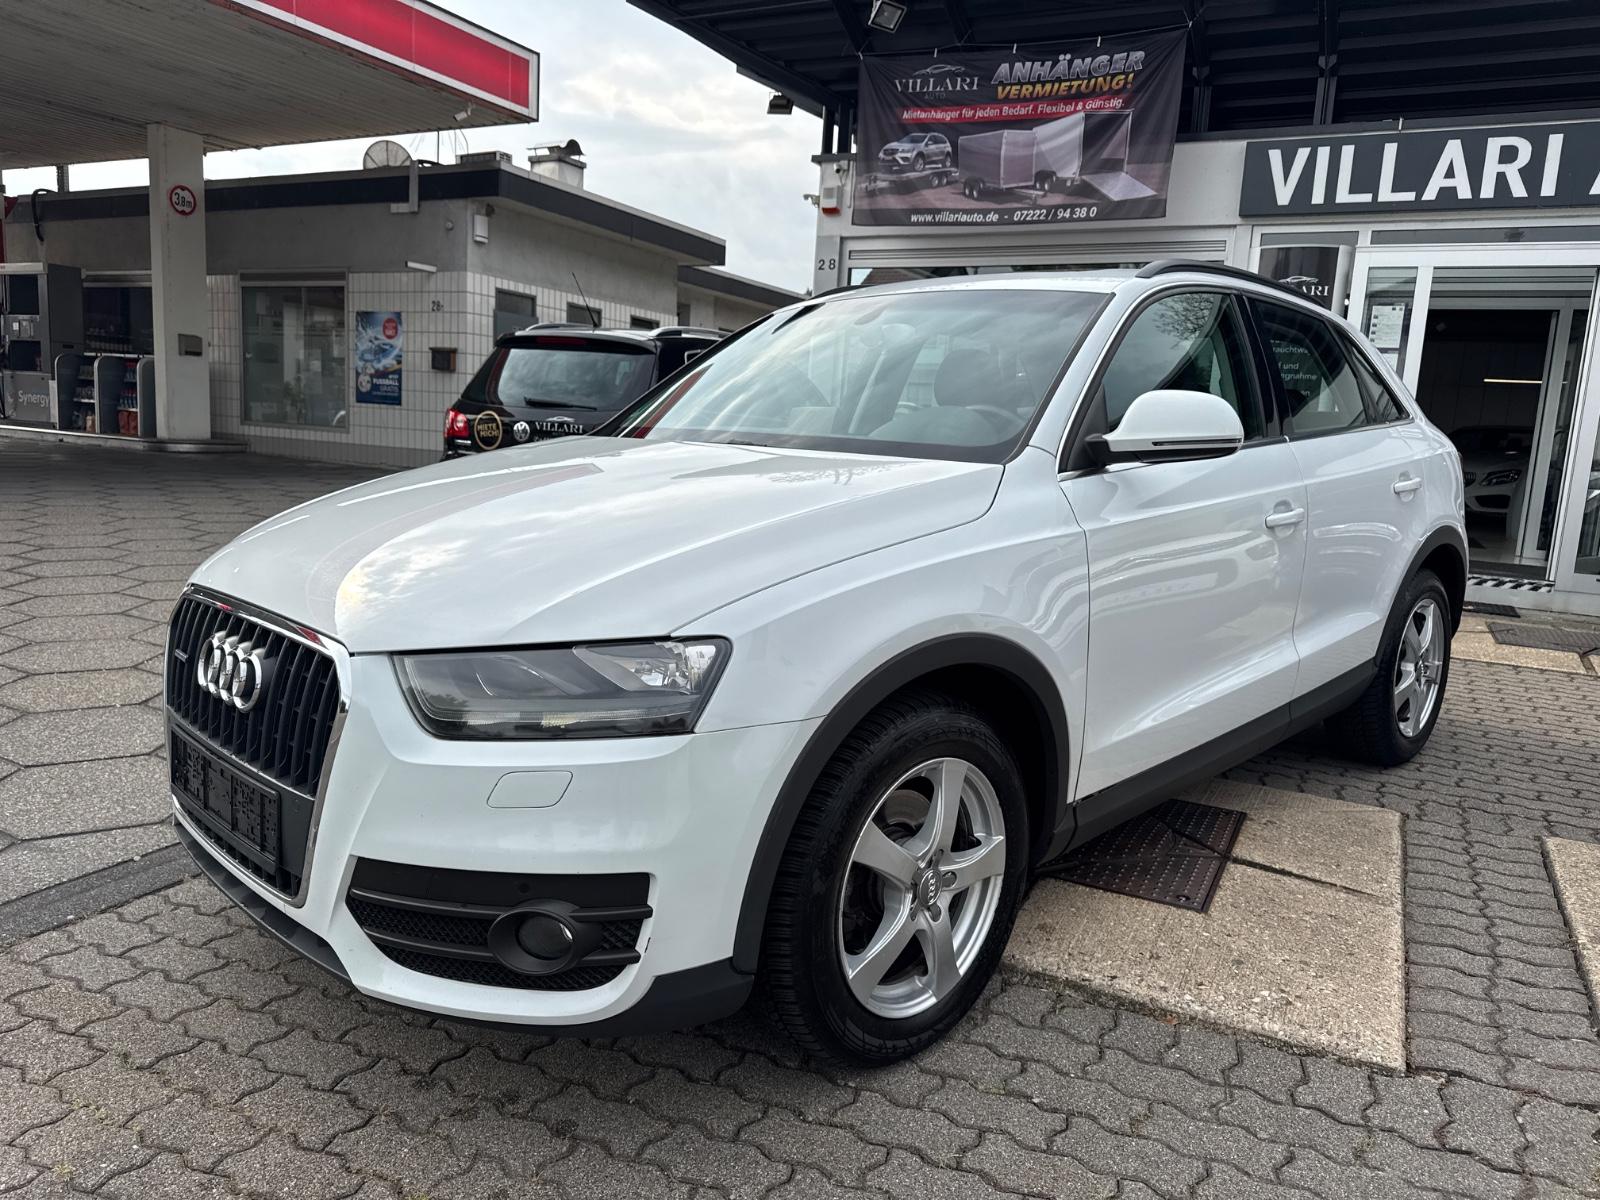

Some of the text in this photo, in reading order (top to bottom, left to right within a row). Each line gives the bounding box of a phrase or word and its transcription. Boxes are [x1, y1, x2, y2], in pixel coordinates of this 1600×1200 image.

[991, 51, 1145, 84] ANHÄNGER
[894, 76, 979, 93] VILLARI
[997, 73, 1135, 99] VERMIETUNG!
[902, 97, 1125, 120] Mietanhänger für jeden Bedarf. Flexibel & Günstig.
[1268, 133, 1564, 206] VILLARI
[910, 211, 999, 223] www.villariauto.de
[1013, 209, 1047, 221] 07222
[1057, 208, 1070, 219] 94
[1072, 207, 1087, 218] 38
[1089, 206, 1097, 217] 0
[818, 258, 836, 271] 28
[18, 390, 50, 408] Synergy
[535, 421, 584, 434] VILLARI
